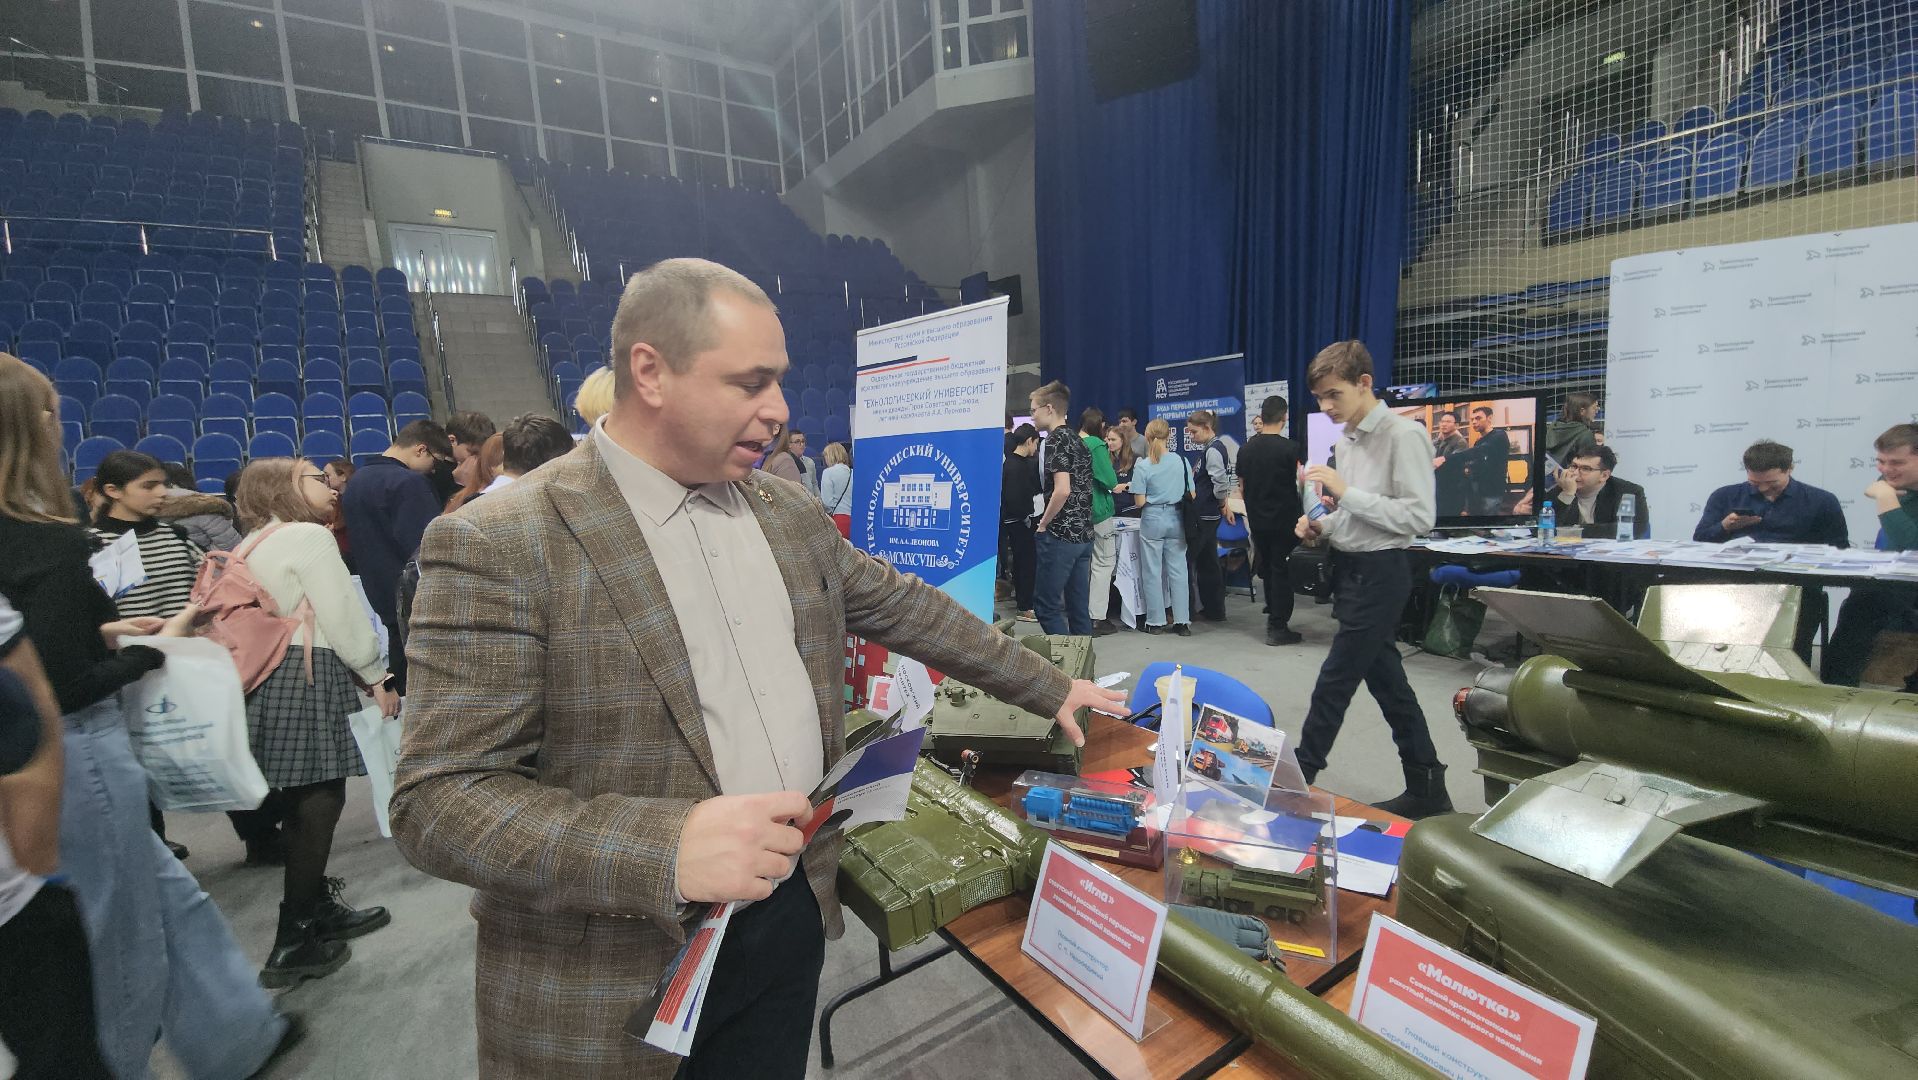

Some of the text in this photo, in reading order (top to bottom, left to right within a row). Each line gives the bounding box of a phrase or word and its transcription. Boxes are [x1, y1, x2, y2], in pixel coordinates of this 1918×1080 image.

[952, 315, 993, 329] образования
[926, 331, 960, 344] Федерации
[960, 365, 1001, 377] образования
[864, 382, 995, 409] ТЕХНОЛОГИЧЕСКИЙ УНИВЕРСИТЕТ
[1157, 400, 1218, 412] БУДЬ ПЕРВЫМ ВМЕСТЕ
[1163, 410, 1186, 419] ПЕРВЫМ
[867, 443, 971, 560] ТЕХНОЛОГИЧЕСКИЙ УНИВЕРСИТЕТ
[888, 551, 937, 568] MCMXCVIII
[1080, 879, 1115, 905] «Игла»
[1417, 962, 1521, 1022] «Малютка»
[1389, 976, 1543, 1066] ракетный комплекс первого поколения
[1409, 976, 1522, 1042] Советский противотанковый
[1380, 1027, 1455, 1078] Сергей Павлович
[1404, 1027, 1440, 1053] Главный
